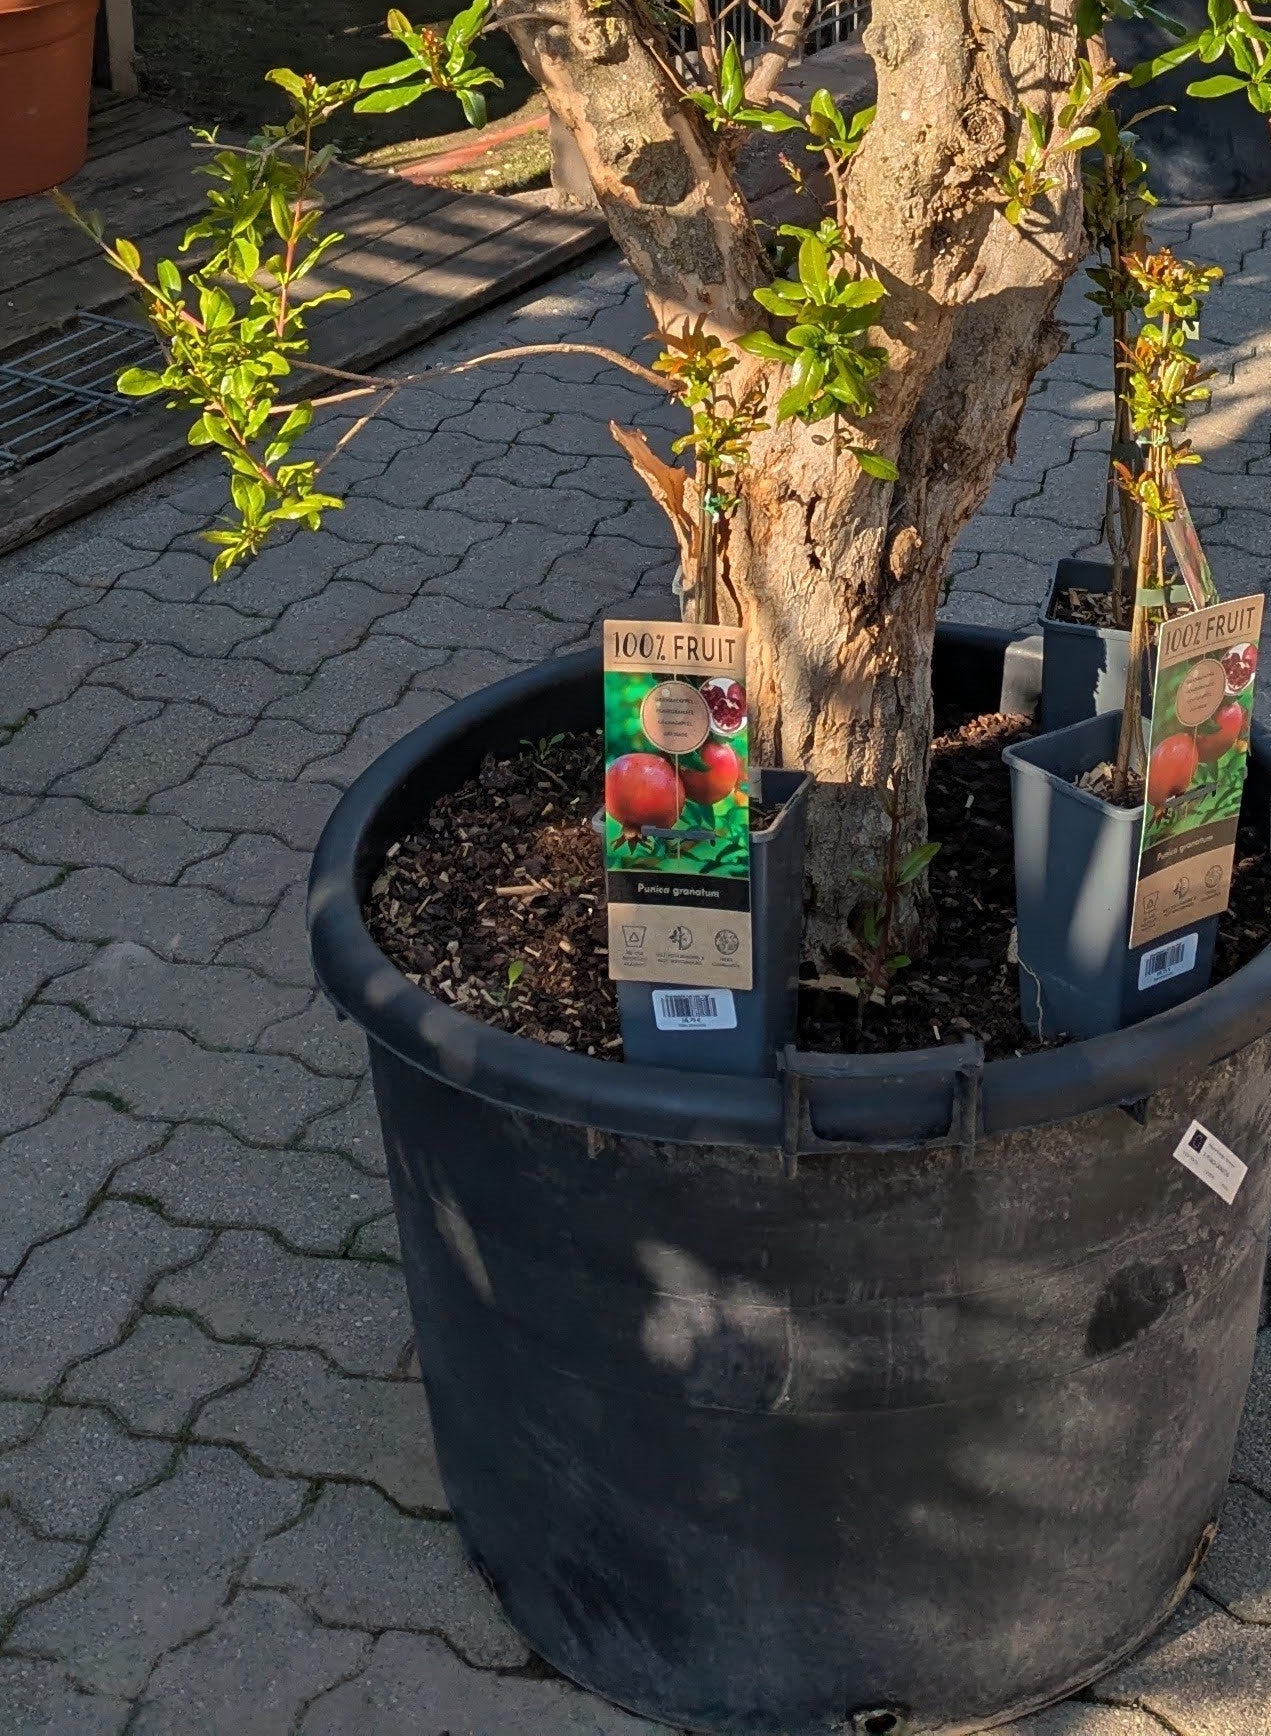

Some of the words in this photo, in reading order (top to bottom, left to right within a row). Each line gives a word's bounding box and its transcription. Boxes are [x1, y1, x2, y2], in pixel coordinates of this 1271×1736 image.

[1166, 621, 1202, 655] 100%
[1206, 606, 1256, 640] FRUIT
[612, 631, 667, 661] 100%
[673, 635, 736, 664] FRUIT
[637, 883, 670, 894] Punica
[672, 887, 720, 898] granatum
